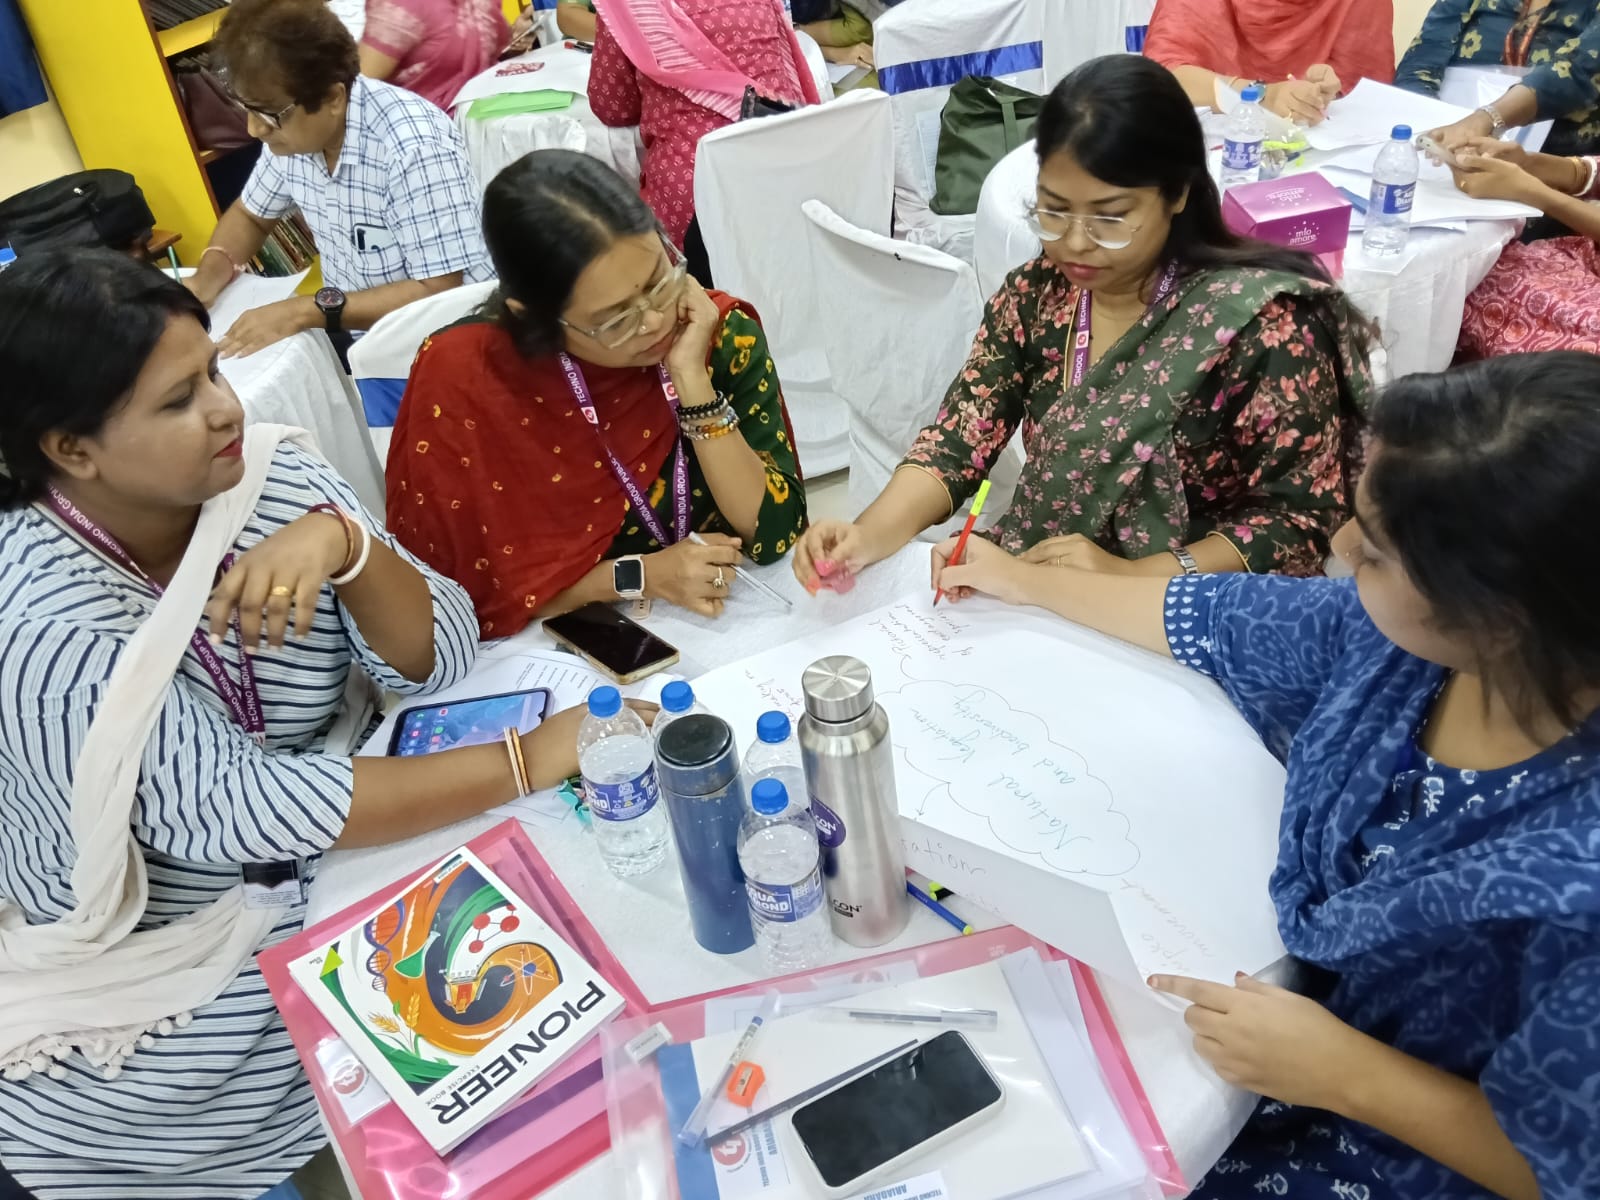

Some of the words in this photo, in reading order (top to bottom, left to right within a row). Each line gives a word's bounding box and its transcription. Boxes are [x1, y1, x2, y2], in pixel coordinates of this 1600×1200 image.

[1289, 234, 1317, 245] amore
[567, 372, 587, 403] TECHNO
[677, 467, 686, 495] GROUP
[626, 482, 644, 506] GROUP
[678, 496, 687, 514] INDIA
[69, 506, 94, 531] INDIA
[640, 504, 652, 524] INDIA
[200, 645, 224, 675] GROUP
[219, 676, 234, 699] INDIA
[240, 665, 252, 689] INDIA
[1033, 758, 1077, 784] and
[987, 772, 1092, 850] Natural
[431, 980, 606, 1125] PIONEER
[447, 1064, 481, 1091] EXERCISE
[426, 1089, 447, 1106] BOOK
